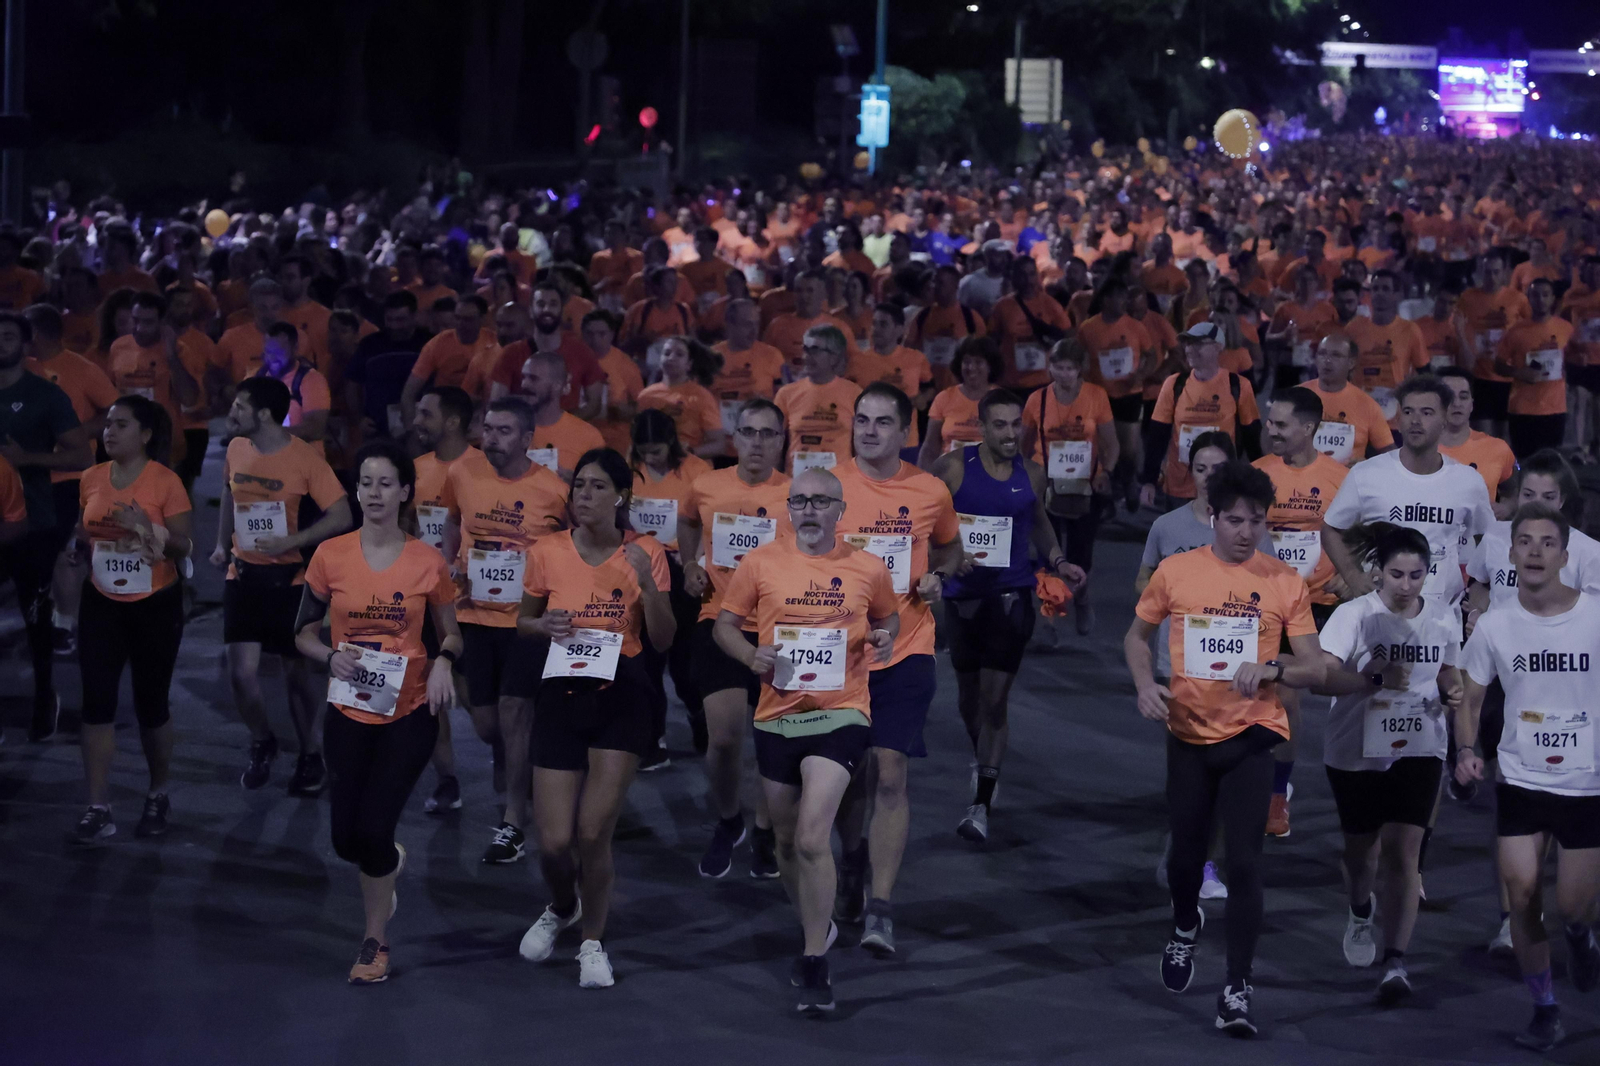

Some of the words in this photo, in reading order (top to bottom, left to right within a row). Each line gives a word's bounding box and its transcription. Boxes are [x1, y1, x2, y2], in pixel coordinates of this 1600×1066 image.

[1317, 435, 1346, 446] 11492
[1058, 454, 1084, 463] 21686
[474, 512, 504, 523] SEVILLA
[491, 508, 524, 520] NOCTURNA
[638, 513, 667, 526] 10237
[1404, 502, 1454, 524] BÍBELO
[247, 518, 274, 530] 9838
[729, 533, 758, 548] 2609
[969, 532, 996, 546] 6991
[1278, 548, 1306, 560] 6912
[105, 559, 140, 573] 13164
[882, 556, 894, 569] 8
[480, 568, 514, 581] 14252
[804, 591, 846, 599] NOCTURNA
[366, 605, 406, 613] NOCTURNA
[785, 598, 822, 606] SEVILLA
[823, 599, 844, 607] KH7
[348, 612, 384, 620] SEVILLA
[1203, 607, 1240, 617] SEVILLA
[566, 644, 602, 658] 5822
[1200, 638, 1244, 654] 18649
[1390, 642, 1439, 663] BÍBELO
[790, 648, 832, 665] 17942
[1529, 649, 1589, 672] BÍBELO
[1381, 718, 1422, 732] 18276
[1533, 732, 1577, 748] 18271
